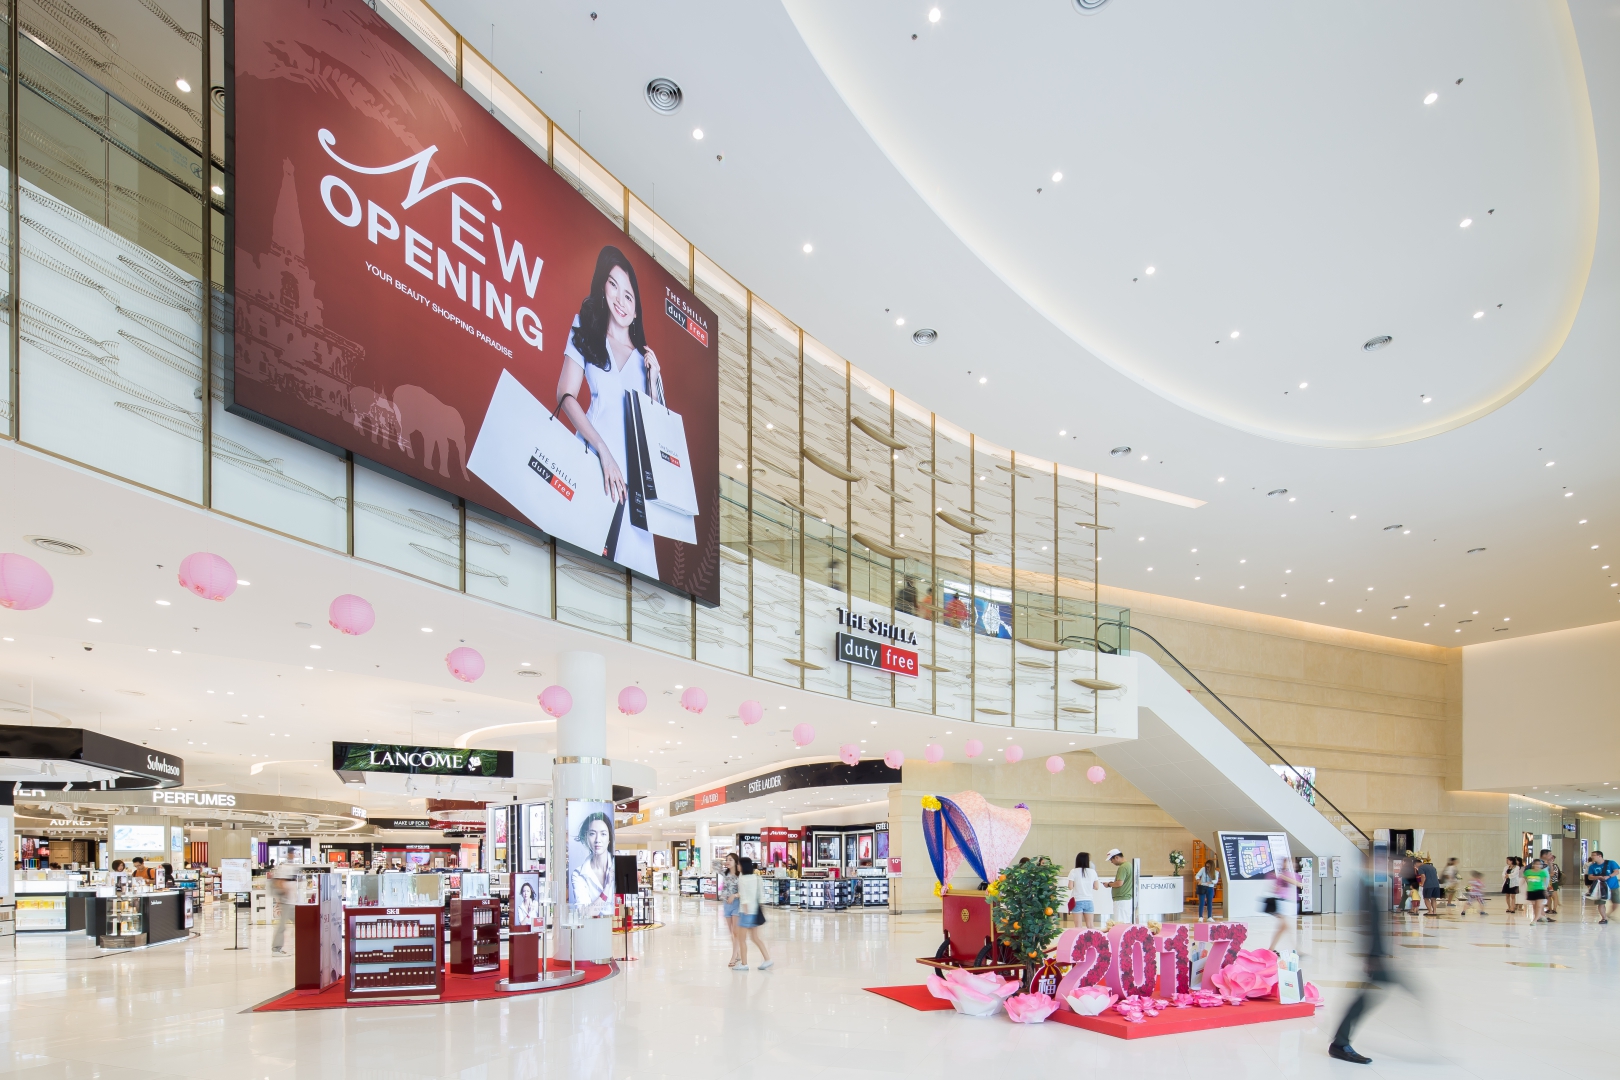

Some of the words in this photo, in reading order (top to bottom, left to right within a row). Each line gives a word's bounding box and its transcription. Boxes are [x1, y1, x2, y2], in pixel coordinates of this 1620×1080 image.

[318, 128, 544, 299] NEW
[320, 175, 543, 351] OPENING
[365, 261, 393, 285] YOUR
[395, 279, 430, 307] BEAUTY
[432, 303, 474, 335] SHOPPING
[476, 330, 513, 359] PARADISE
[665, 286, 681, 306] THE
[682, 301, 708, 330] SHILLA
[668, 305, 686, 326] duty
[689, 322, 706, 341] free
[531, 461, 550, 480] duty
[553, 479, 571, 497] free
[534, 446, 550, 464] THE
[551, 462, 577, 489] SHILLA
[837, 607, 867, 630] THE
[869, 617, 918, 645] SHILLA
[845, 638, 878, 665] duty
[886, 649, 914, 670] free
[147, 754, 180, 776] Sulwhasoo
[369, 750, 463, 769] LANCÔME
[152, 791, 236, 807] PERFUMES
[1140, 882, 1177, 890] INFORMATION
[1056, 921, 1249, 1011] 2017
[1038, 974, 1056, 995] 福
